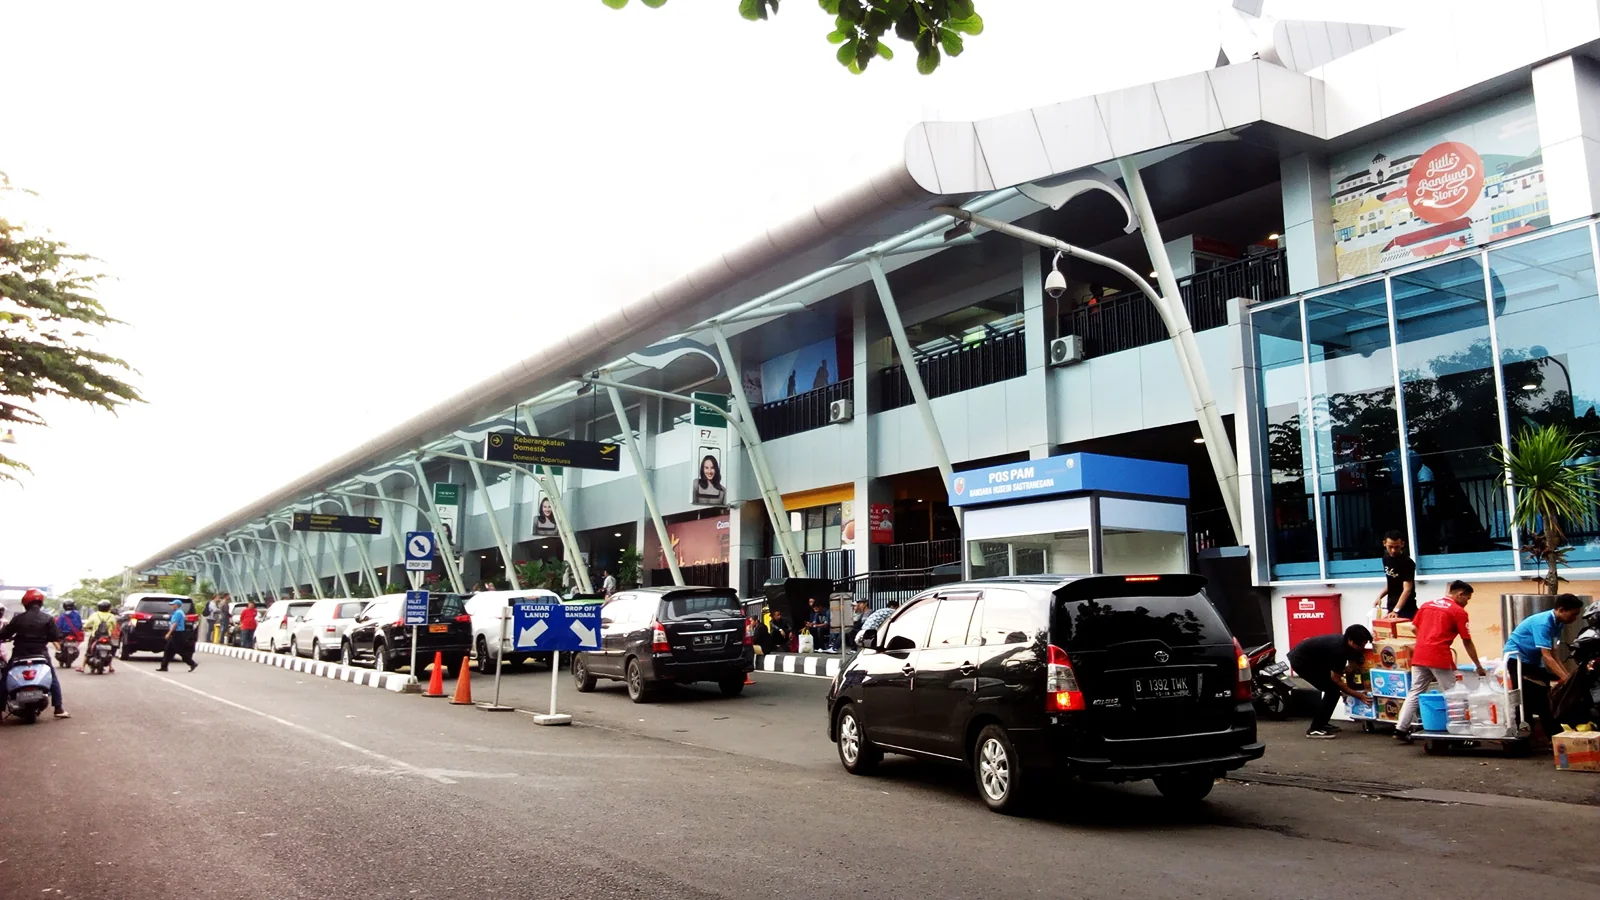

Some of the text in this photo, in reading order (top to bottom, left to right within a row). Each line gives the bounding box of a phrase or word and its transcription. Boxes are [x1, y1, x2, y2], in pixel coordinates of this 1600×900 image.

[1416, 164, 1475, 196] Bandung
[700, 429, 711, 438] F7
[513, 435, 565, 447] Keberangkatan
[513, 443, 546, 453] Domestik
[988, 472, 1009, 484] POS
[1011, 467, 1034, 480] PAM
[1135, 677, 1188, 692] B 1392 TWK
